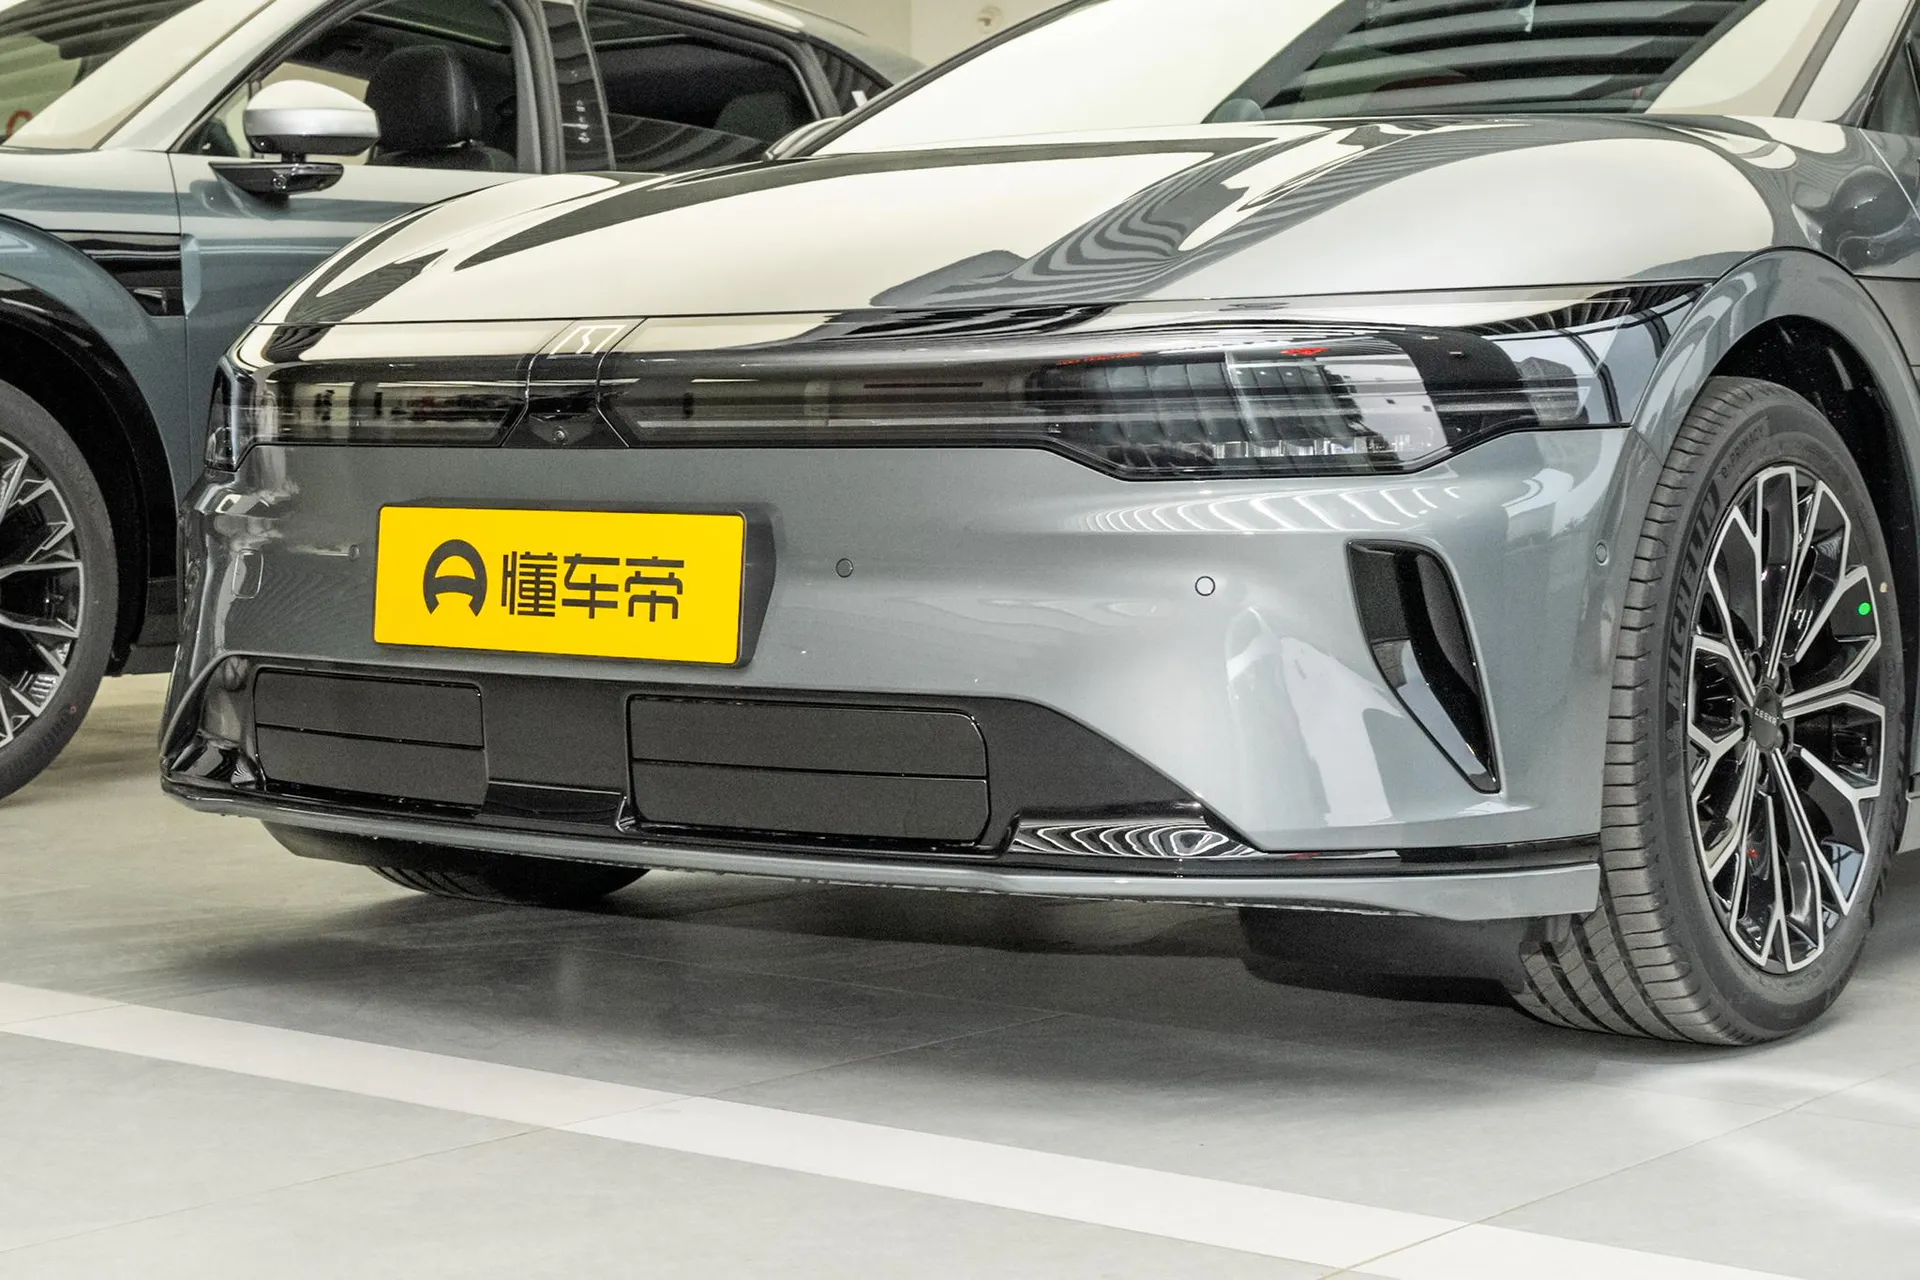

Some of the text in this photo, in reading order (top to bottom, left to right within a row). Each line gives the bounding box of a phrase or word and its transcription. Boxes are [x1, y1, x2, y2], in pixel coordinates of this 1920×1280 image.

[501, 551, 685, 622] 懂车帝
[1667, 492, 1717, 710] MICHELIN
[1754, 707, 1777, 727] ZEEKR
